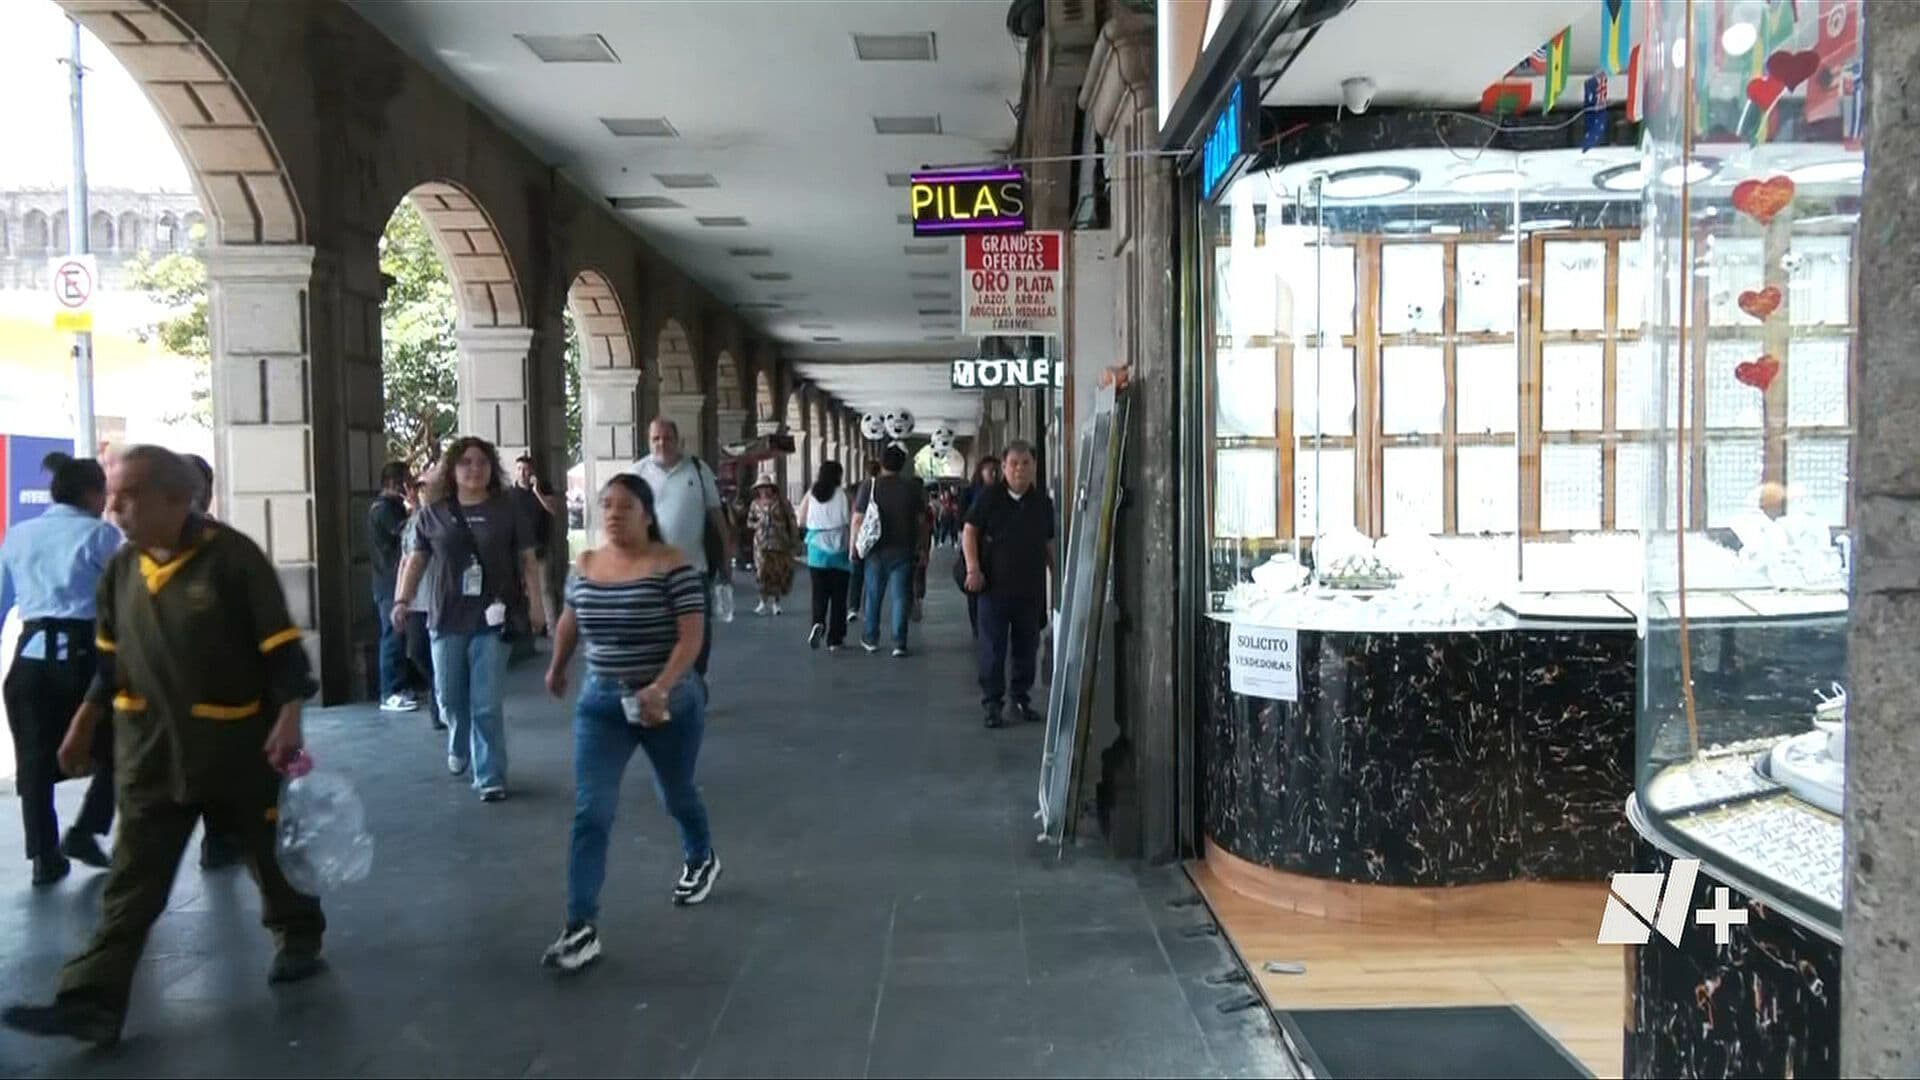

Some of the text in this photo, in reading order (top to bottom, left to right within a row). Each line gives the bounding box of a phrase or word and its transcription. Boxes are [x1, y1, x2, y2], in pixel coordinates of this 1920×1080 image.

[911, 182, 1024, 220] PILAS
[981, 235, 1045, 253] GRANDES
[982, 253, 1045, 271] OFERTAS
[65, 270, 81, 299] E
[972, 271, 1054, 292] ORO PLATA
[978, 294, 1046, 305] LAZOS ARRAS
[970, 306, 1057, 317] ARGOLLAS MEDALLAS
[1237, 635, 1289, 653] SOLICITO
[1235, 655, 1293, 672] VENDEDORAS
